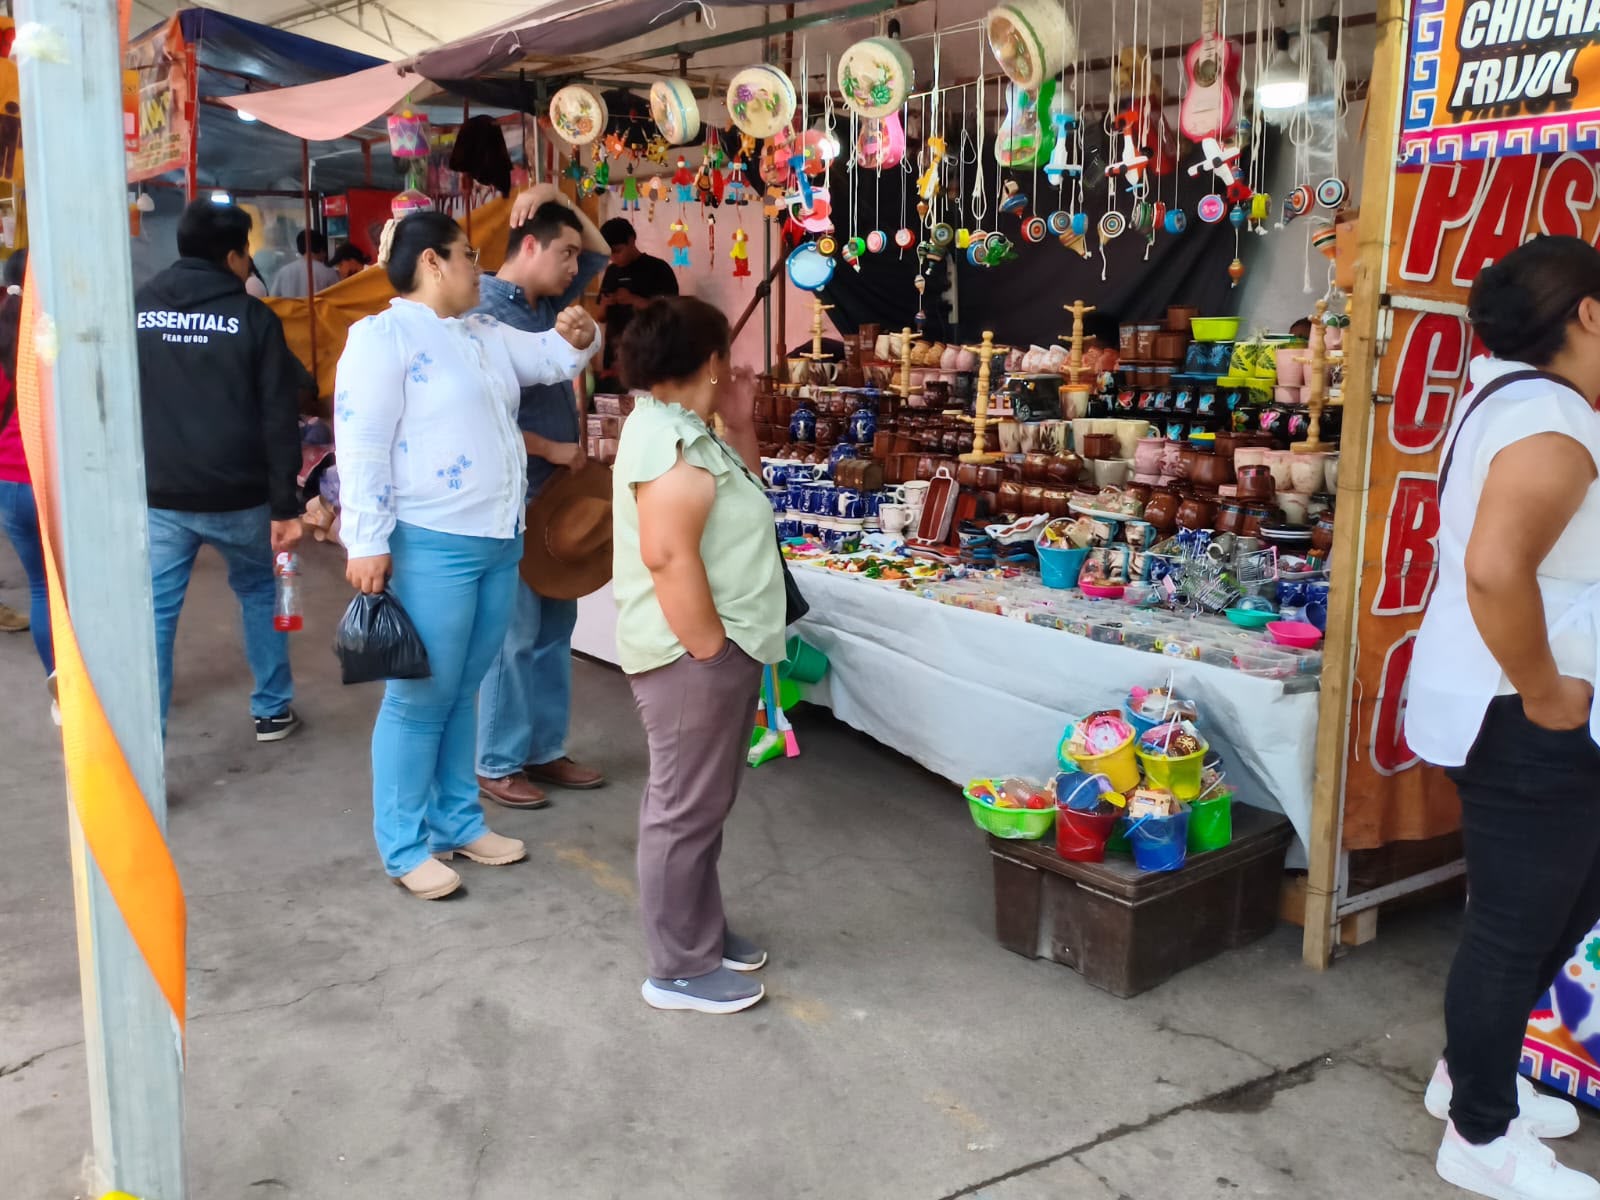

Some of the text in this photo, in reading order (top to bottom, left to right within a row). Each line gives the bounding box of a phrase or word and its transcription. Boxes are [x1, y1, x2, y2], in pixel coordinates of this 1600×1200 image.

[1451, 48, 1577, 107] FRIJOL
[1400, 151, 1600, 287] PAS
[137, 310, 239, 334] ESSENTIALS
[162, 333, 209, 344] FEAR OF GOD
